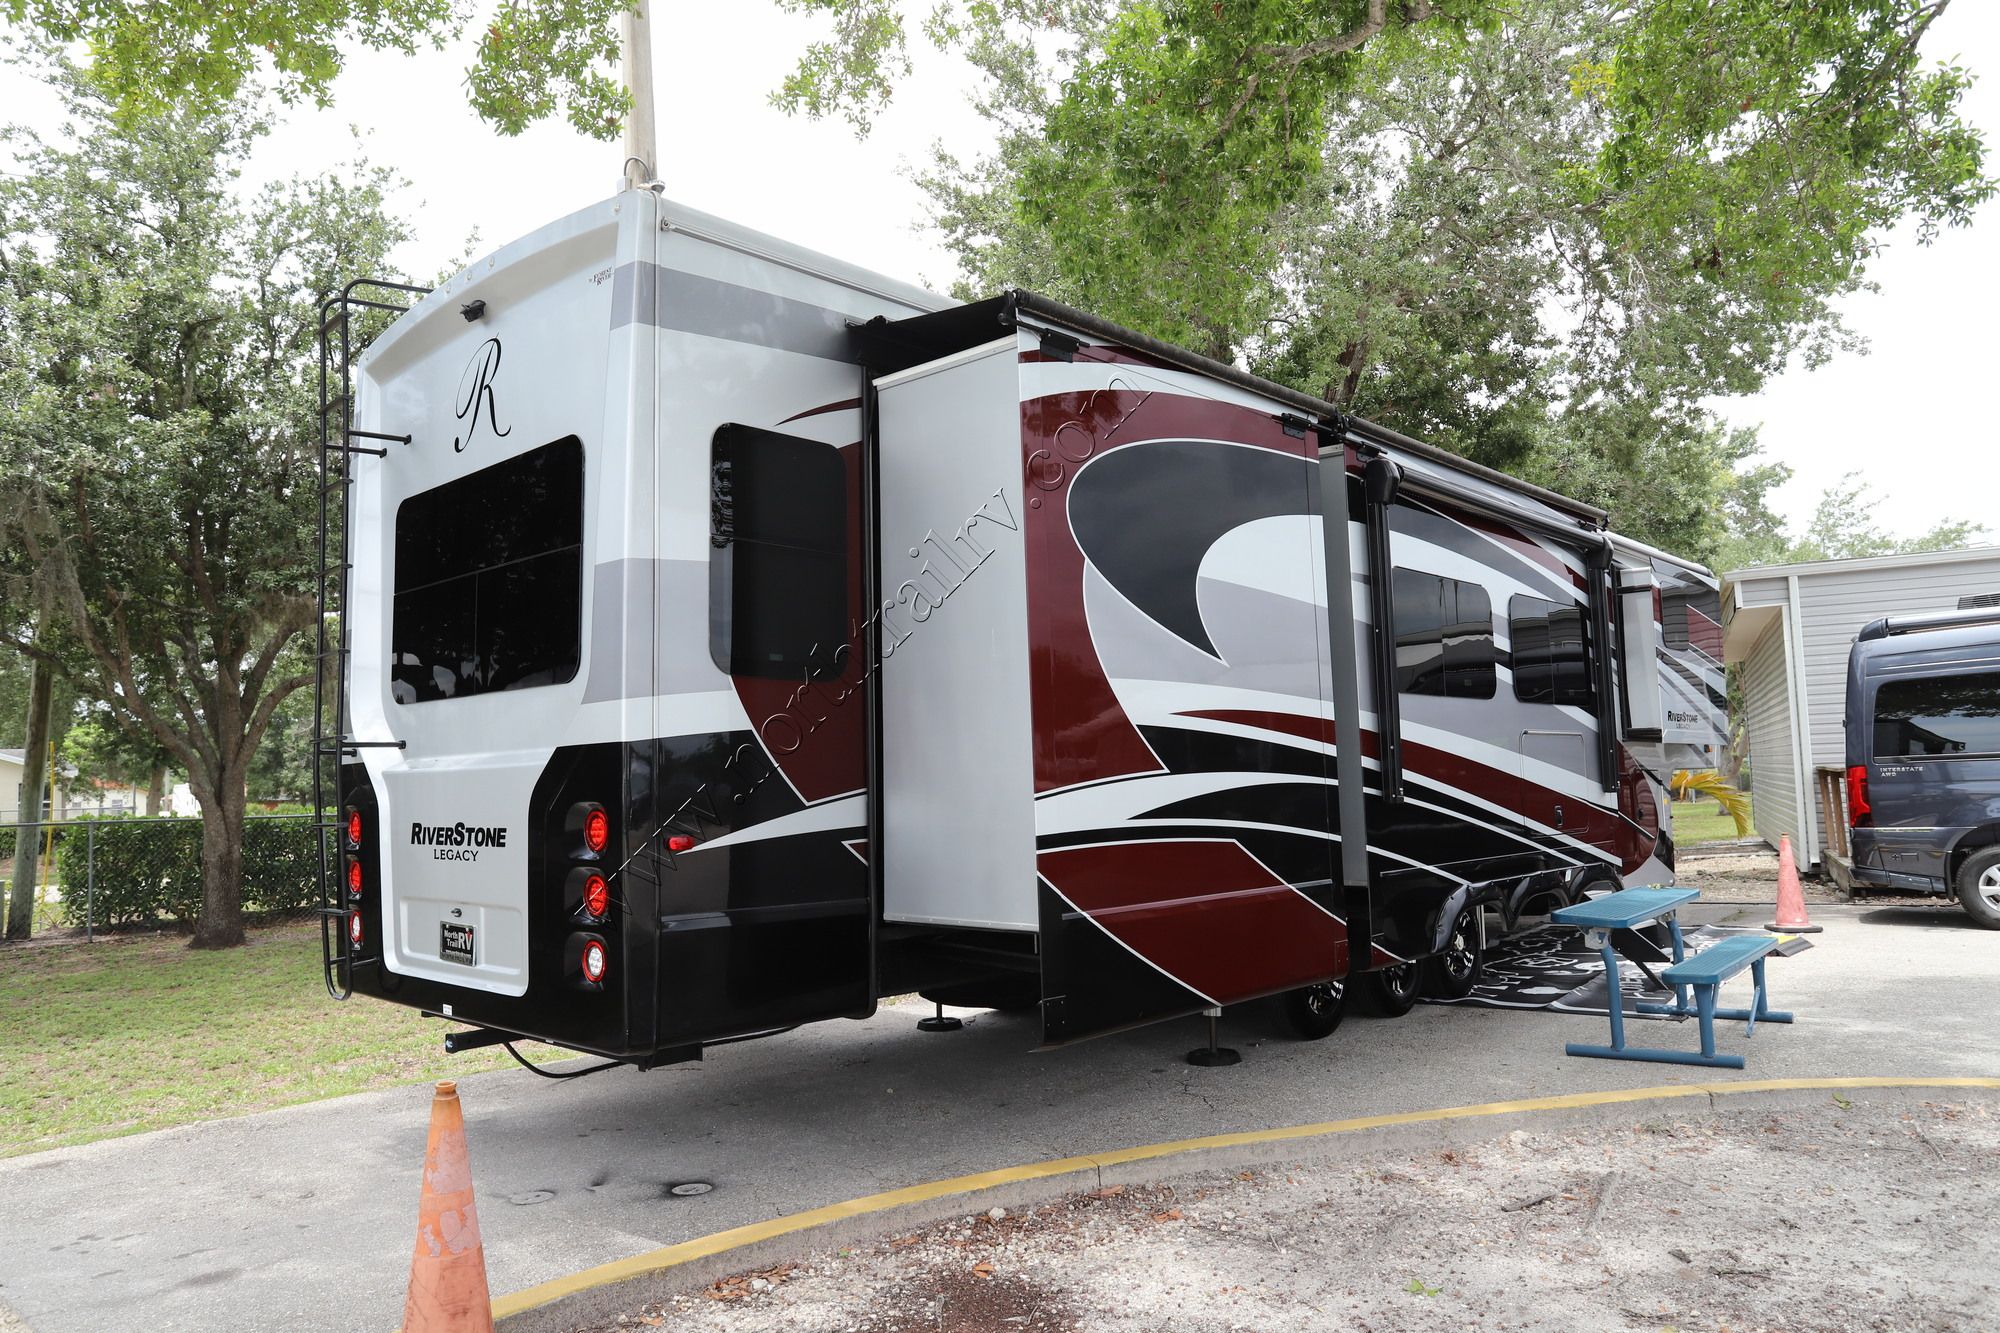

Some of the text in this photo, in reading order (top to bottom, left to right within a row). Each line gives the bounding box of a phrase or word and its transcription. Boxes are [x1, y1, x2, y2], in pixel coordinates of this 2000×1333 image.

[433, 848, 479, 862] LEGACY
[443, 929, 473, 951] North RV
[446, 938, 459, 948] Trail
